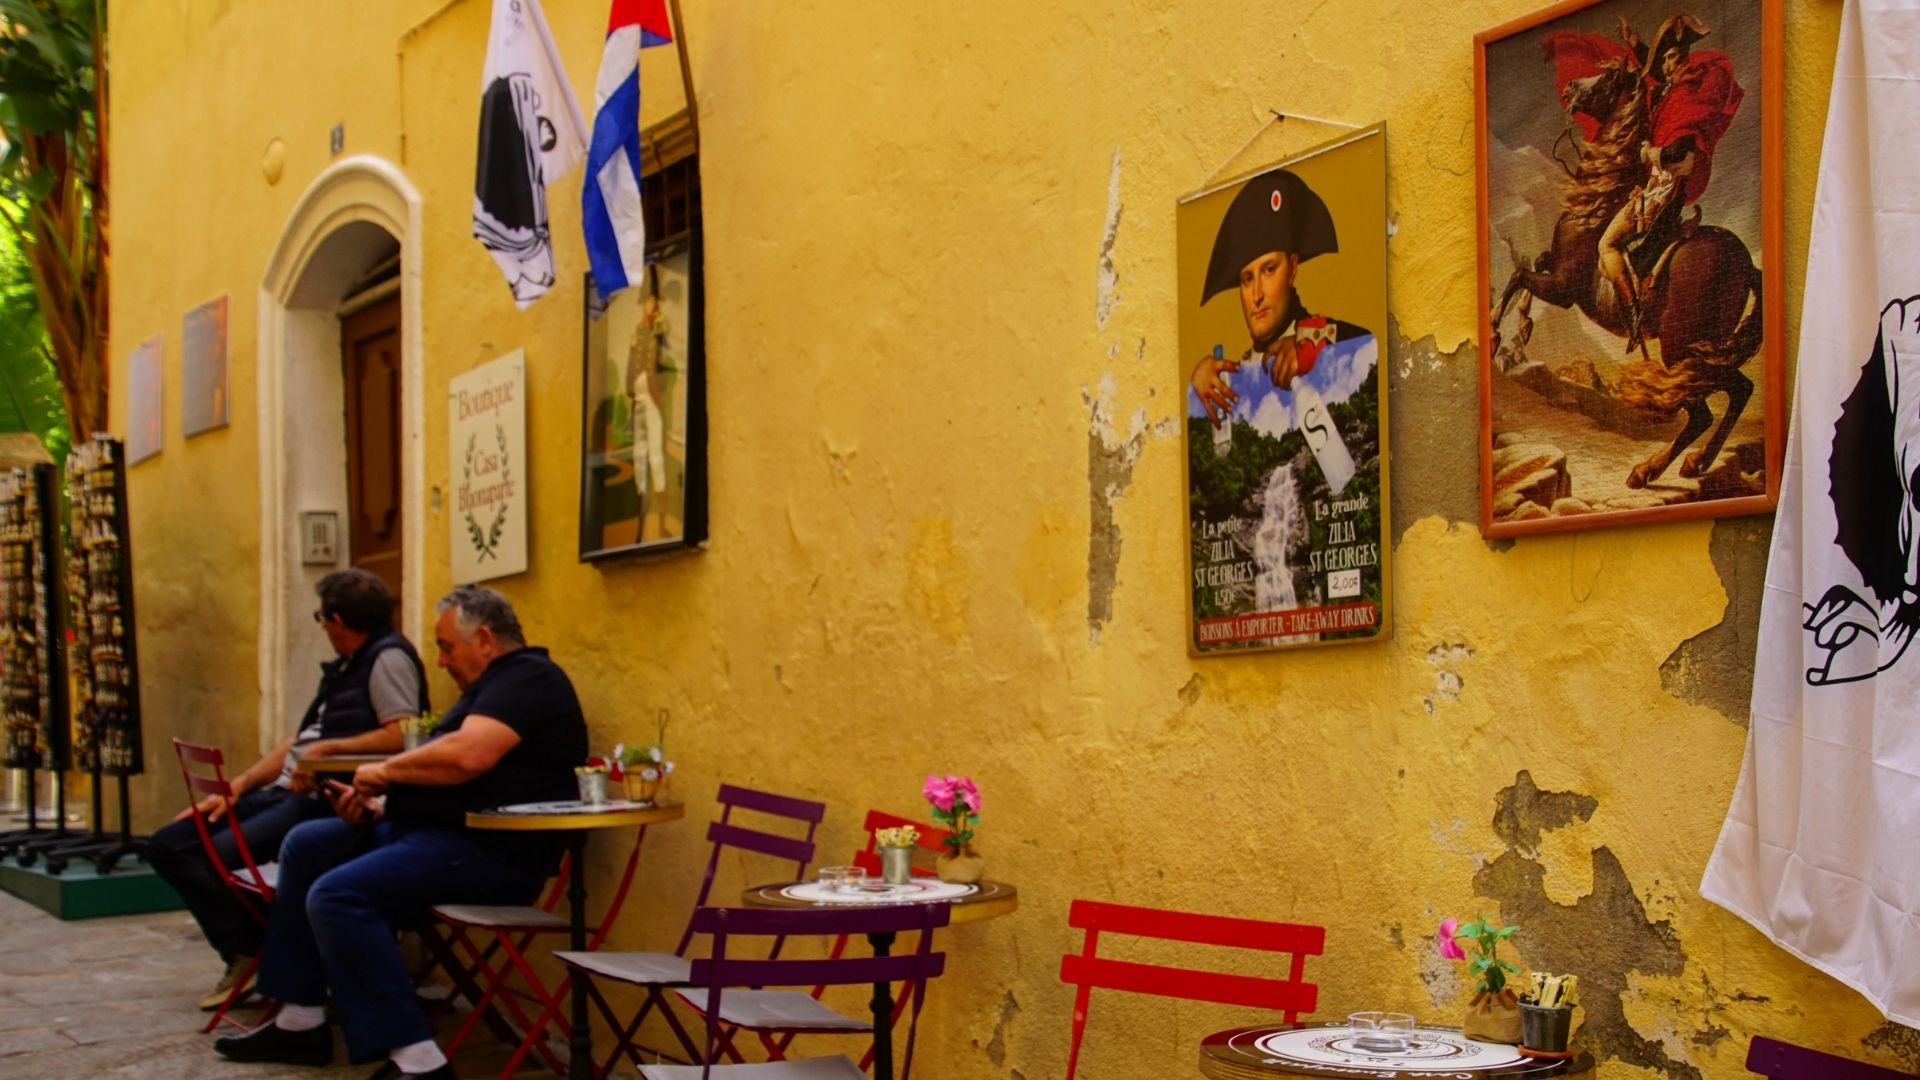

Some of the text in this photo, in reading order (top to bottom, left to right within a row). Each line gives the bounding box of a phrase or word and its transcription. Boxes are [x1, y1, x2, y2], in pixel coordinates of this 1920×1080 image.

[458, 380, 514, 421] Boutique
[473, 449, 498, 477] Casa
[1315, 492, 1369, 521] La grande
[1202, 514, 1242, 539] La petite
[1328, 520, 1356, 545] ZILIA
[1211, 540, 1235, 562] ZILIA
[1310, 543, 1377, 573] ST GEORGES
[1195, 561, 1254, 589] ST GEORGES
[1200, 621, 1233, 642] BOISSONS
[1241, 615, 1284, 638] EMPORTER
[1291, 611, 1338, 633] TAKE-AWAY
[1341, 606, 1374, 628] DRINKS
